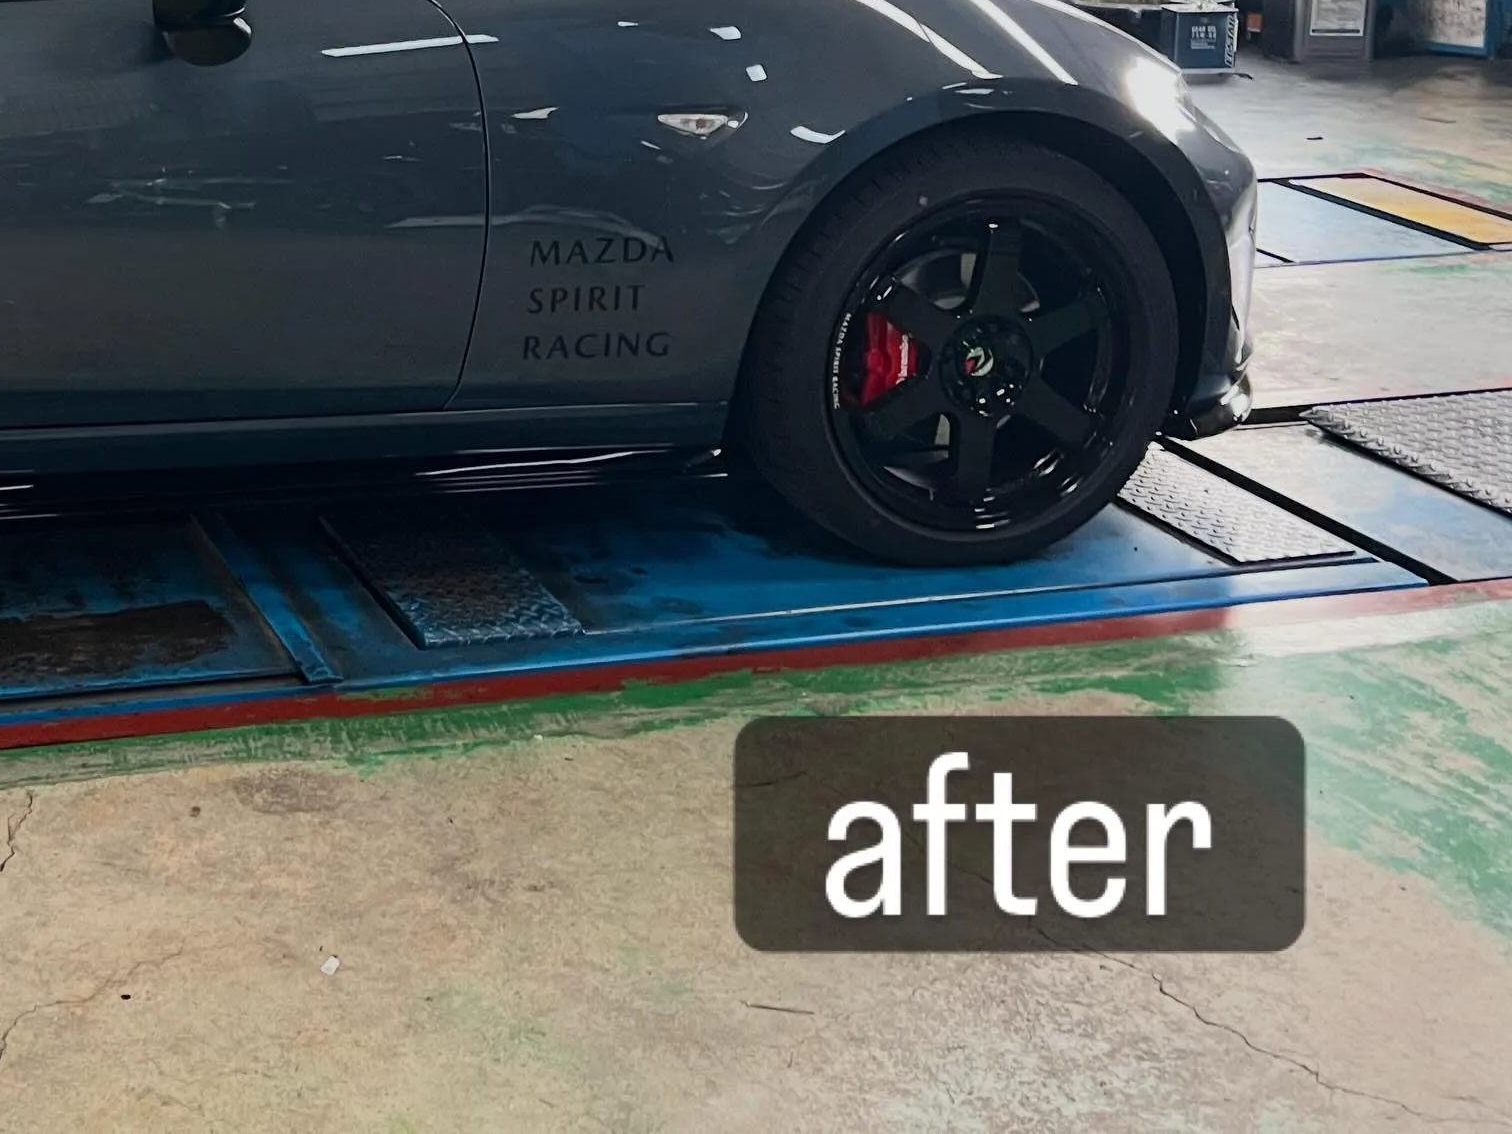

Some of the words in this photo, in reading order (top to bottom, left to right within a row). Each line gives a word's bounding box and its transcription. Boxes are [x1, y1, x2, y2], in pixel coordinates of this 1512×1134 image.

[530, 235, 675, 267] MAZDA
[526, 284, 646, 314] SPIRIT
[522, 331, 671, 361] RACING
